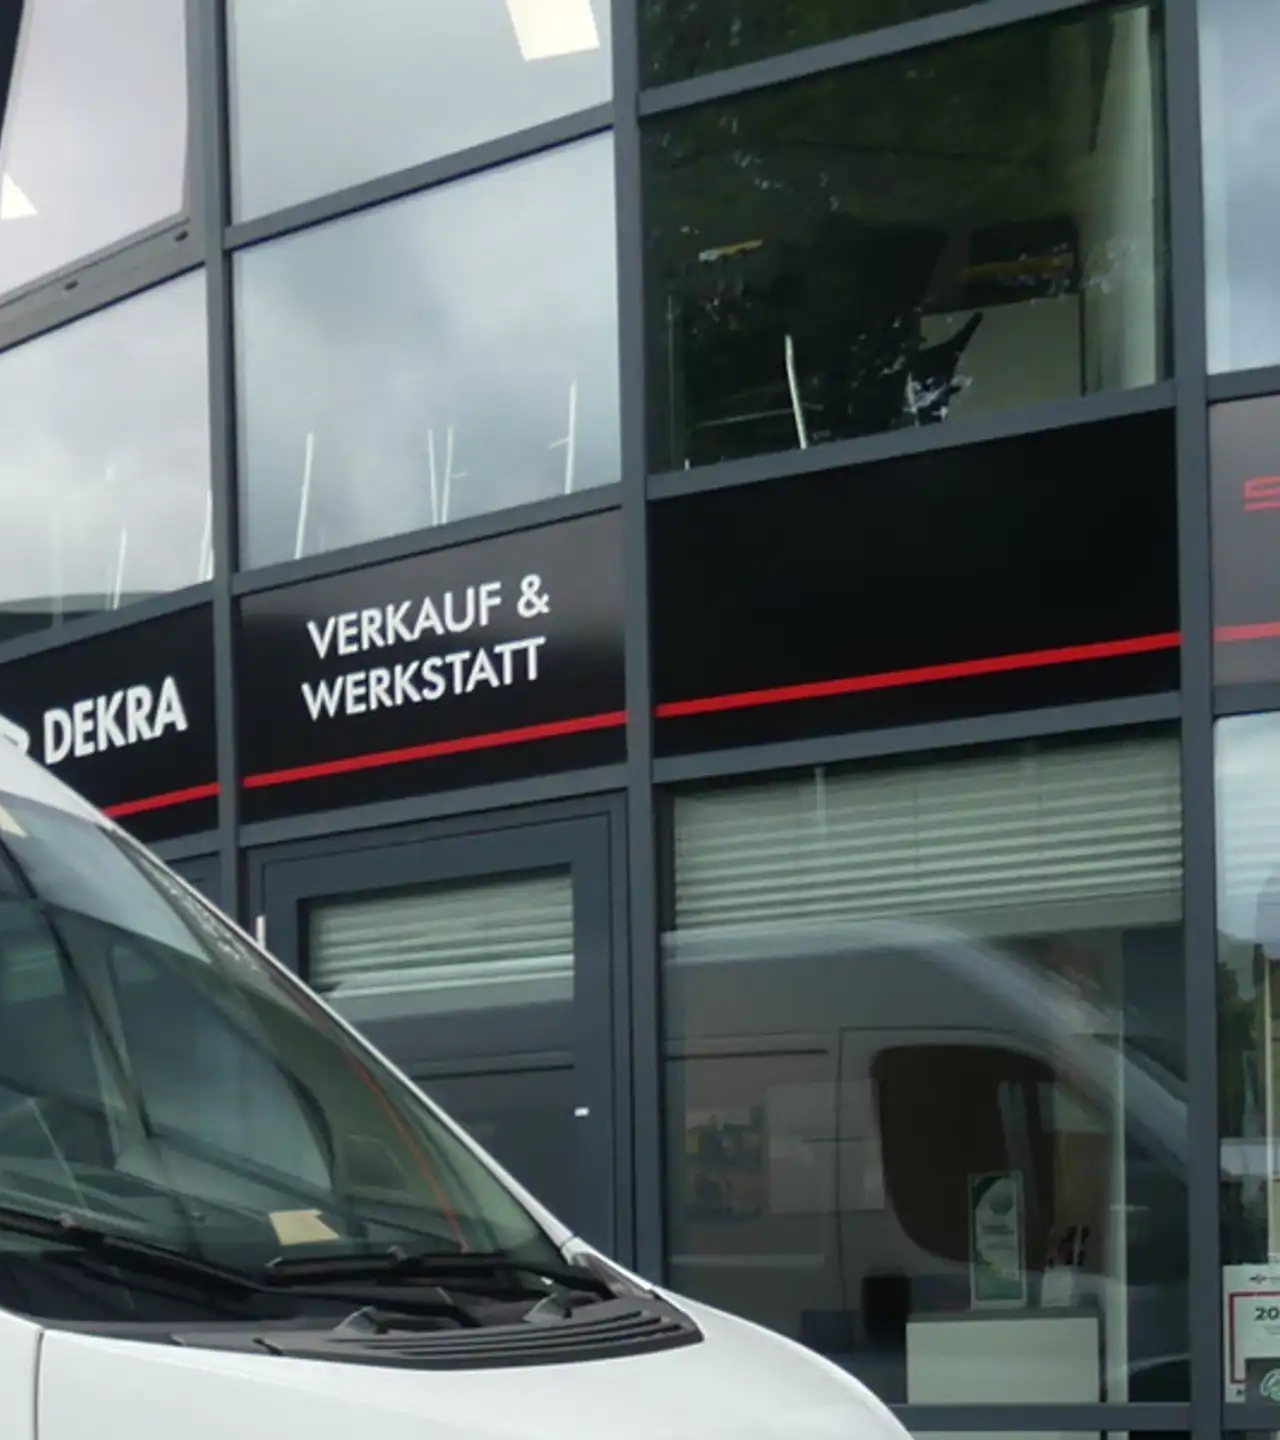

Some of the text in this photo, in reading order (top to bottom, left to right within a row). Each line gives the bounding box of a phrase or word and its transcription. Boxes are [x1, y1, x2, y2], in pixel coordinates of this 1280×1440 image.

[306, 573, 551, 659] VERKAUF &
[43, 676, 188, 765] DEKRA
[301, 636, 546, 722] WERKSTATT
